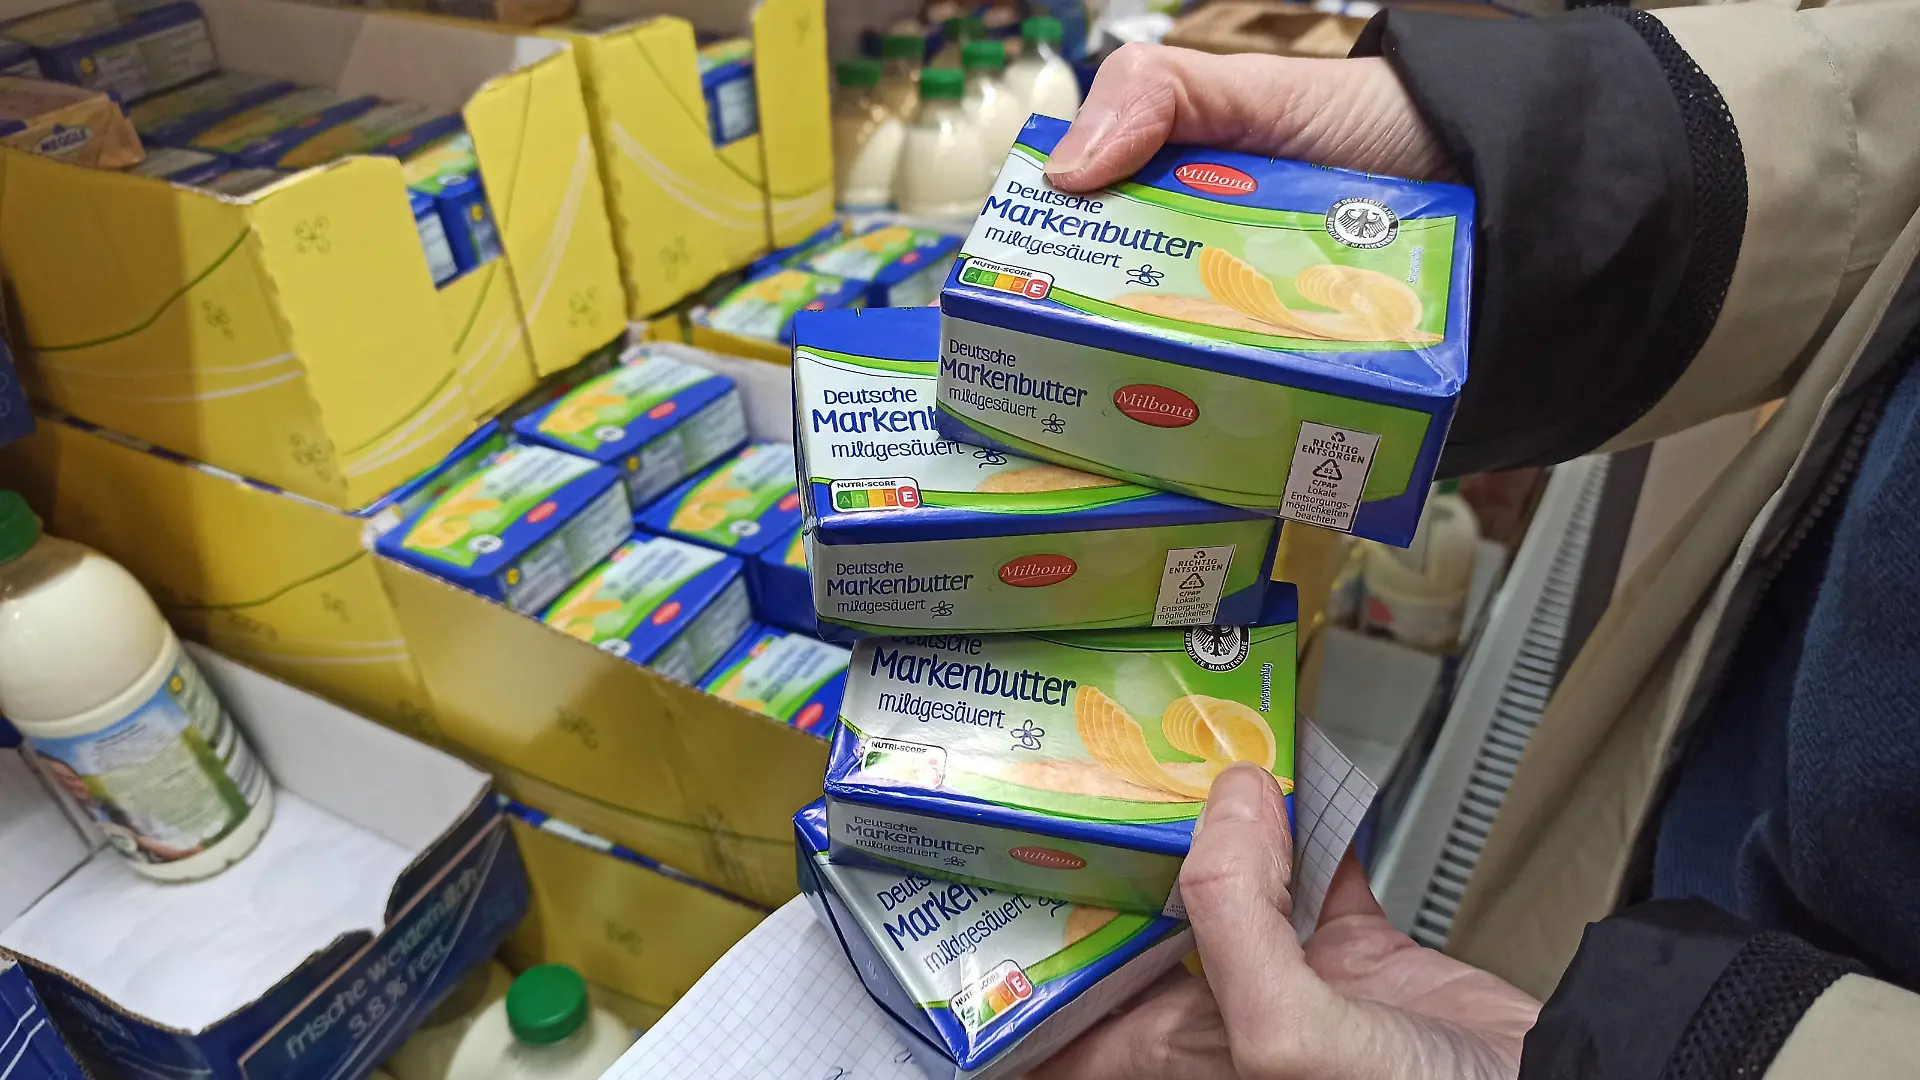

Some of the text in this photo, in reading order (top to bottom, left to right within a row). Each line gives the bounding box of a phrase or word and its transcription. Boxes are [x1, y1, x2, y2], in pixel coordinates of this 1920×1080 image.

[1176, 165, 1254, 192] Milbona
[1007, 180, 1103, 214] Deutsche
[980, 195, 1203, 260] Markenbutter
[984, 225, 1122, 270] mildgesäuert
[972, 259, 1033, 278] NUTRI-SCORE
[1029, 283, 1044, 295] E
[949, 339, 1016, 368] Deutsche
[939, 355, 1088, 408] Markenbutter
[824, 386, 918, 405] Deutsche
[948, 385, 1038, 419] mildgesäuert
[1116, 389, 1195, 420] Milbona
[831, 439, 965, 462] mildgesäuert
[1301, 444, 1365, 464] ENTSORGEN
[1312, 438, 1359, 455] RICHTIG
[1323, 467, 1334, 475] 82
[837, 480, 896, 489] NUTRI-SCORE
[1307, 486, 1337, 498] Lokale
[1312, 479, 1338, 489] C/PAP
[901, 491, 915, 502] E
[1290, 491, 1351, 510] Entsorgungs-
[1285, 501, 1349, 518] möglichkeiten
[1295, 510, 1336, 525] beachten
[836, 561, 904, 576] Deutsche
[1000, 561, 1073, 580] Milbona
[1169, 564, 1223, 574] ENTSORGEN
[1178, 558, 1217, 567] RICHTIG
[826, 572, 974, 596] Markenbutter
[837, 598, 926, 615] mildgesäuert
[1161, 603, 1212, 613] Entsorgungs-
[1175, 596, 1201, 604] Lokale
[1157, 609, 1211, 621] möglichkeiten
[1165, 617, 1201, 626] beachten
[1208, 640, 1248, 671] MARKENWARE
[870, 646, 1077, 707] Markenbutter
[878, 692, 1006, 729] mildgesäuert
[871, 740, 928, 754] NUTRI-SCORE
[854, 815, 918, 833] Deutsche
[845, 823, 985, 856] Markenbutter
[855, 838, 939, 859] mildgesäuert
[923, 892, 1031, 974] mildgesäuert
[1011, 975, 1027, 993] E
